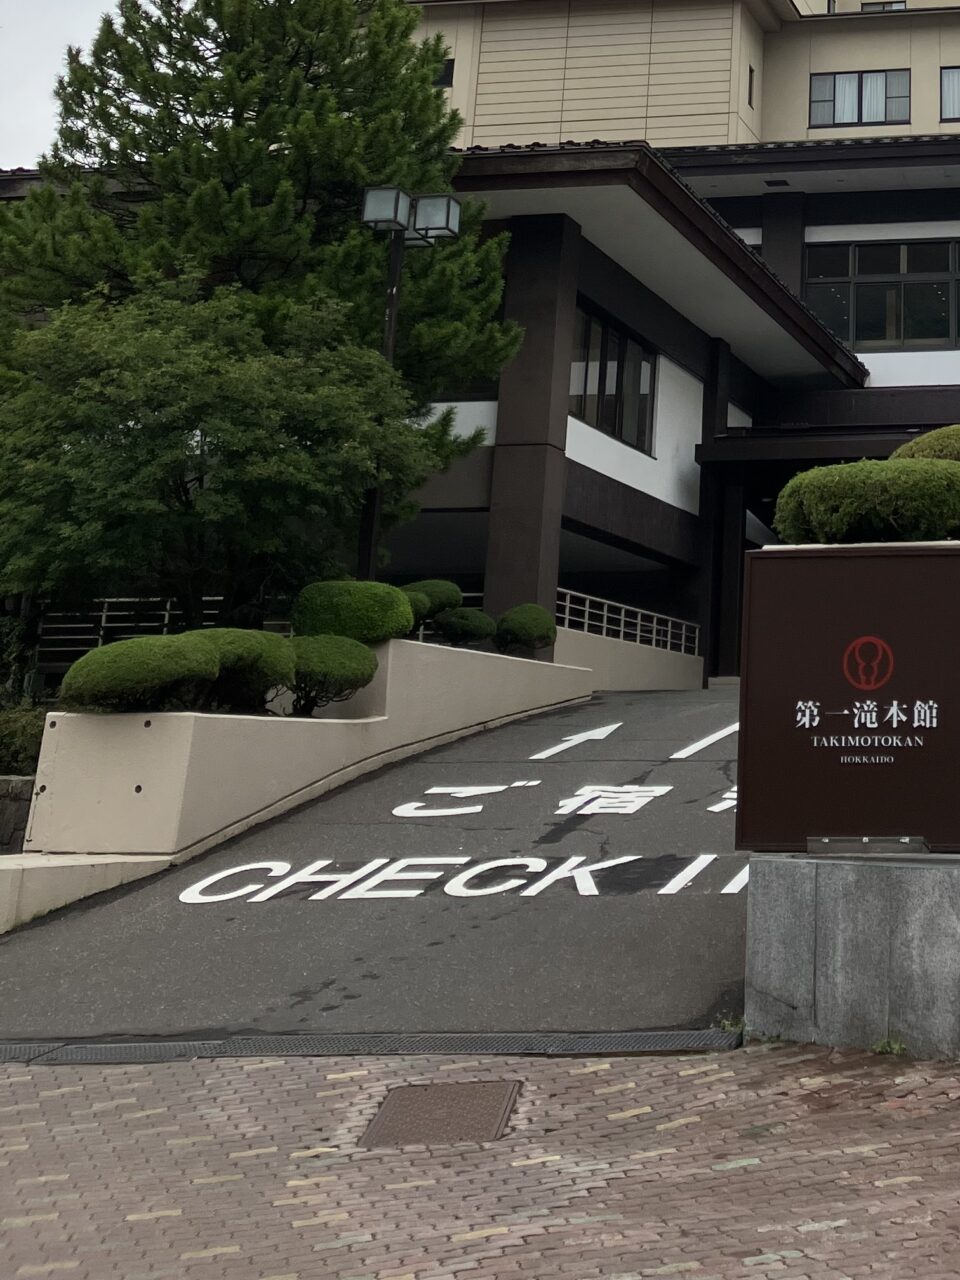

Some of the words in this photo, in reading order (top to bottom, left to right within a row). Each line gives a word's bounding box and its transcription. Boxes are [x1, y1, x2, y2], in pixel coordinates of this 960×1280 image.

[795, 700, 938, 728] 第一滝本館
[811, 735, 924, 747] TAKIMOTOKAN
[840, 755, 894, 763] HOKKAIDO
[179, 855, 643, 904] CHECK
